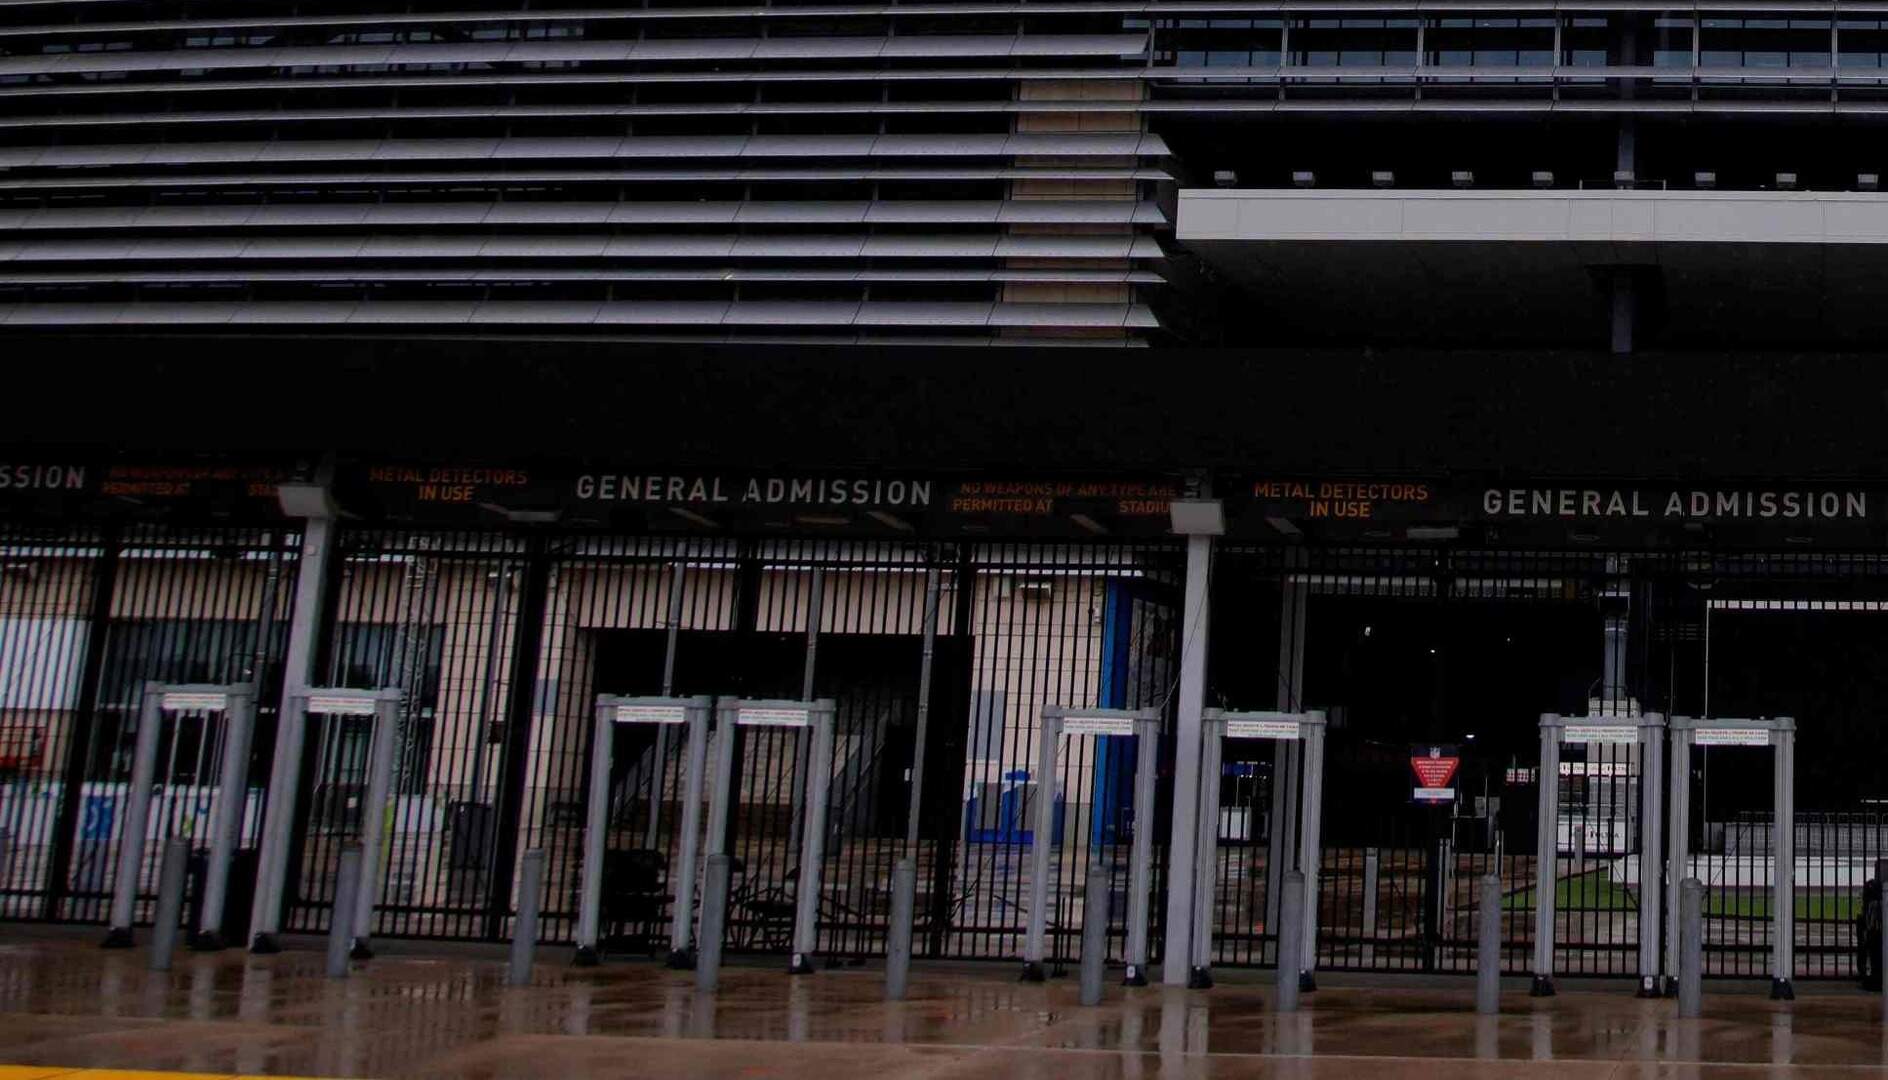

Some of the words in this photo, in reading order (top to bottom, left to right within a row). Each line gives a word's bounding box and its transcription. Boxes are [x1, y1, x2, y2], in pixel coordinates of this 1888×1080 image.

[368, 466, 425, 483] METAL
[428, 467, 529, 486] DETECTORS
[417, 485, 437, 501] IN
[440, 485, 474, 502] USE
[575, 475, 730, 502] GENERAL
[741, 477, 932, 505] ADMISSION
[1254, 482, 1315, 499] METAL
[1320, 483, 1428, 501] DETECTORS
[952, 498, 1032, 513] PERMITTED
[1119, 500, 1170, 514] STADIU
[1309, 500, 1332, 517] IN
[1335, 501, 1371, 518] USE
[1482, 489, 1650, 516] GENERAL
[1663, 491, 1867, 518] ADMISSION
